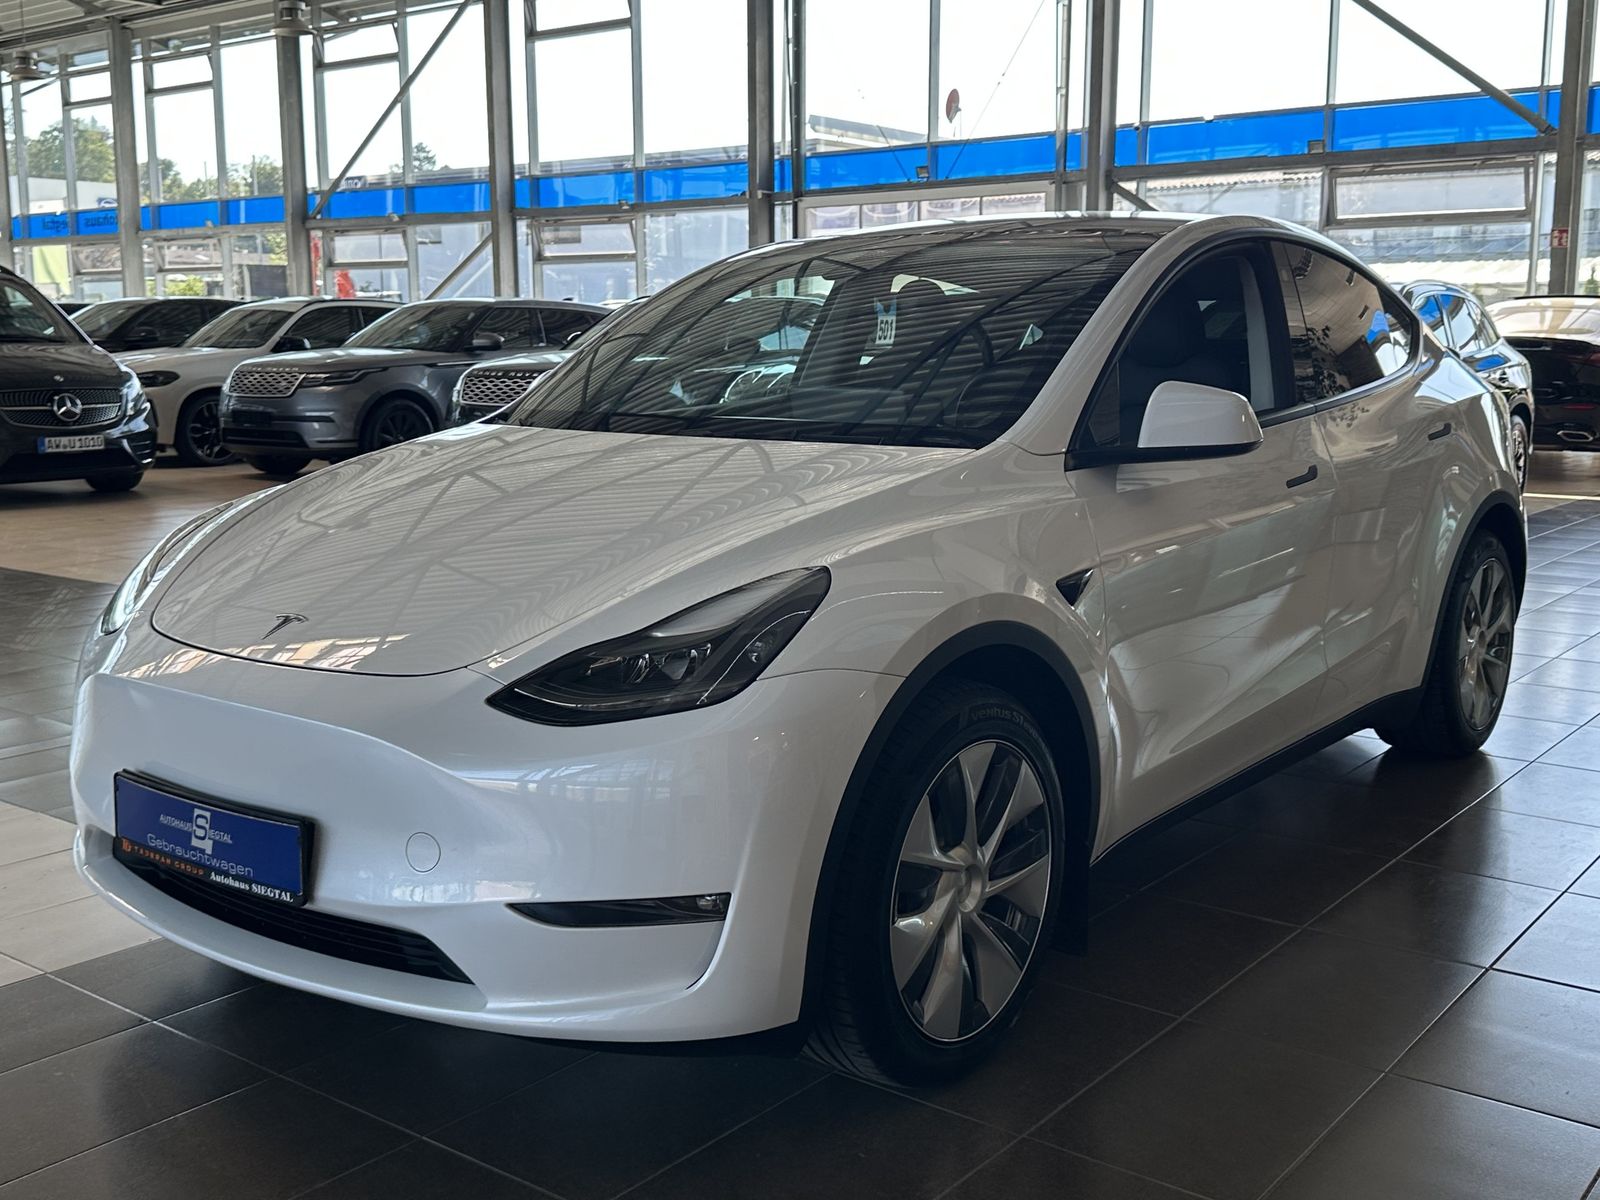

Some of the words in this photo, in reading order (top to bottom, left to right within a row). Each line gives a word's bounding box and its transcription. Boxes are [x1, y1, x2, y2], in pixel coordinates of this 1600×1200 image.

[878, 319, 894, 341] 501
[159, 813, 193, 832] AUTOHAUS
[147, 833, 254, 877] Gebrauchtwagen
[209, 871, 250, 890] Autohaus
[251, 883, 294, 903] SIEGTAL
